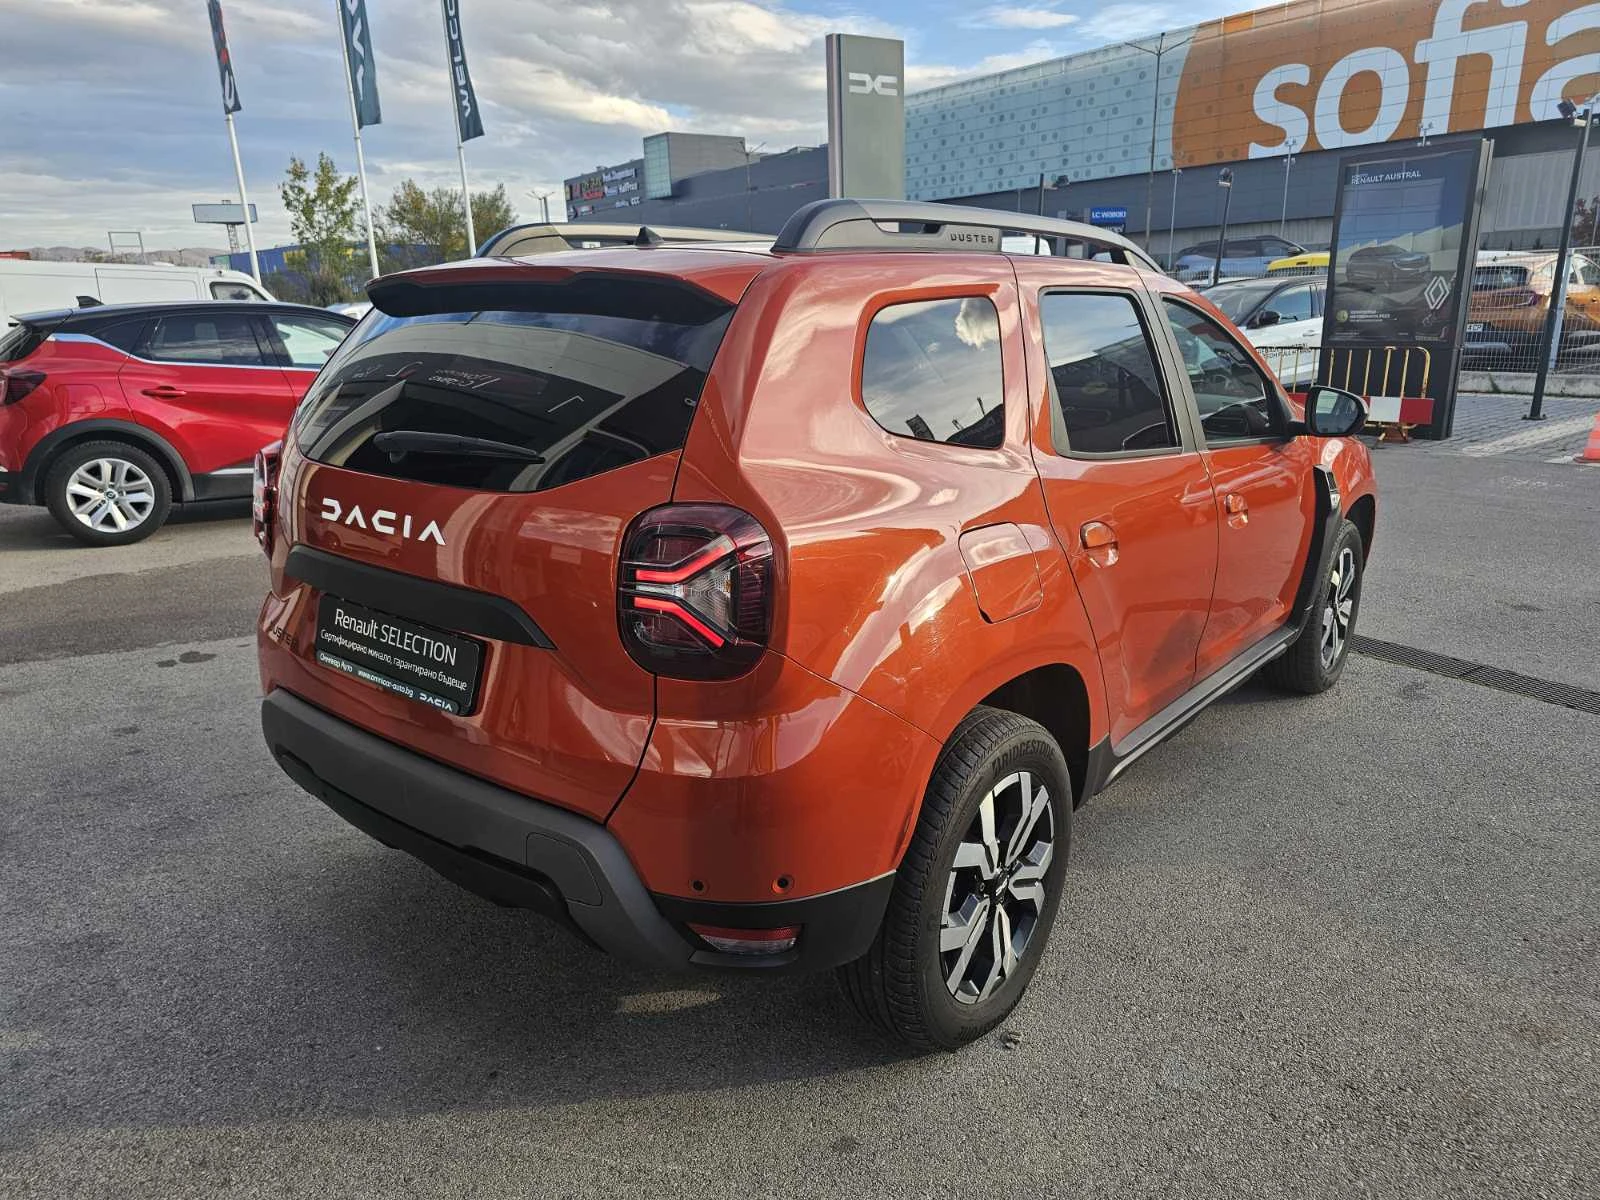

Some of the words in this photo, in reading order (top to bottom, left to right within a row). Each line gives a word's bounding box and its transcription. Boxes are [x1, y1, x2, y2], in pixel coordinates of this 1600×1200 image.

[950, 233, 994, 244] DUSTER
[321, 498, 446, 546] DACIA
[335, 608, 379, 639] Renault
[380, 624, 457, 667] SELECTION
[394, 657, 438, 680] гарантирано
[438, 671, 468, 691] бъдеще
[419, 692, 453, 712] DACIA
